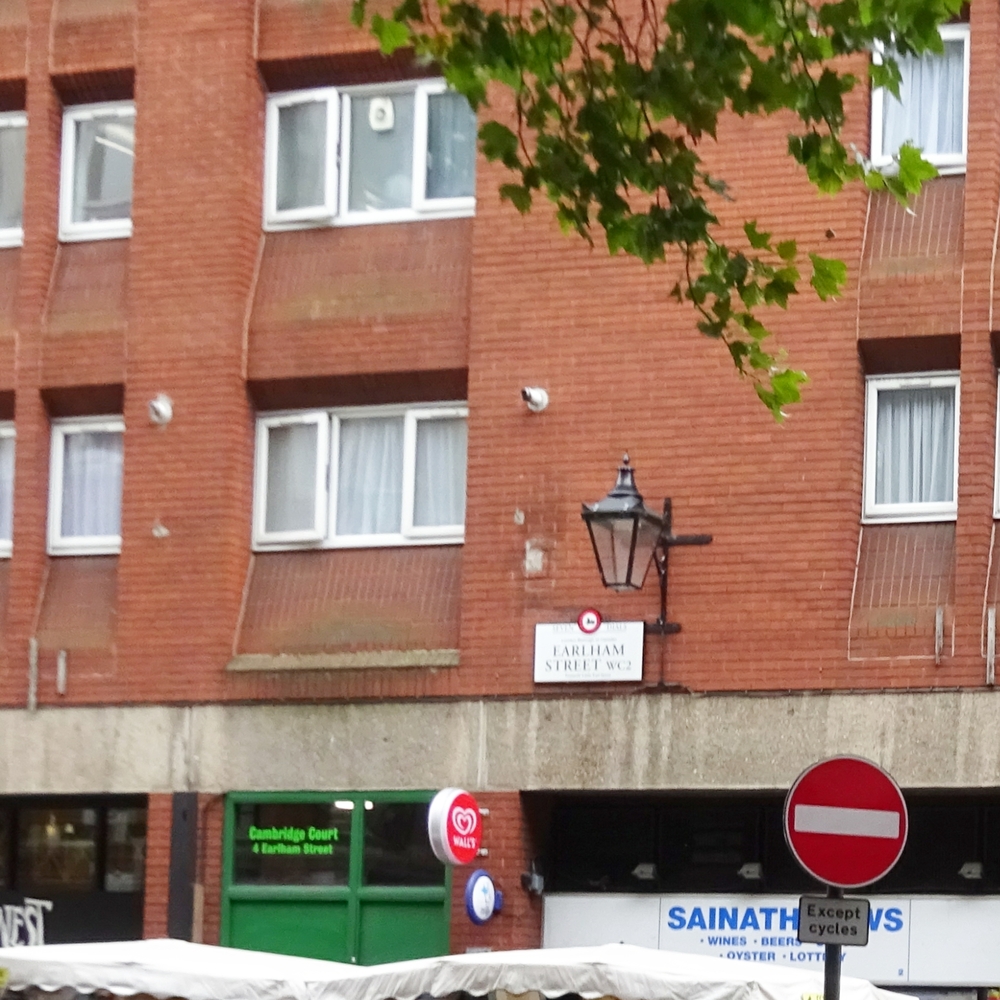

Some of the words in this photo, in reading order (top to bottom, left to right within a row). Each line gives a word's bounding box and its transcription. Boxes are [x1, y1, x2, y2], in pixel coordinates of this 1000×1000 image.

[553, 644, 625, 657] EARLHAM
[545, 659, 600, 672] STREET
[606, 661, 632, 671] WC2
[249, 826, 306, 843] Cambridge
[308, 826, 338, 841] Court
[252, 842, 259, 854] 4
[261, 842, 300, 854] Earlham
[303, 842, 333, 854] Street
[453, 836, 476, 849] WALL'S
[667, 906, 799, 932] SAINATH
[807, 904, 861, 921] Except
[809, 923, 858, 936] cycles
[708, 936, 747, 946] WINES
[761, 937, 802, 947] BEERS
[727, 951, 776, 962] OYSTER
[790, 952, 847, 962] LOTTY
